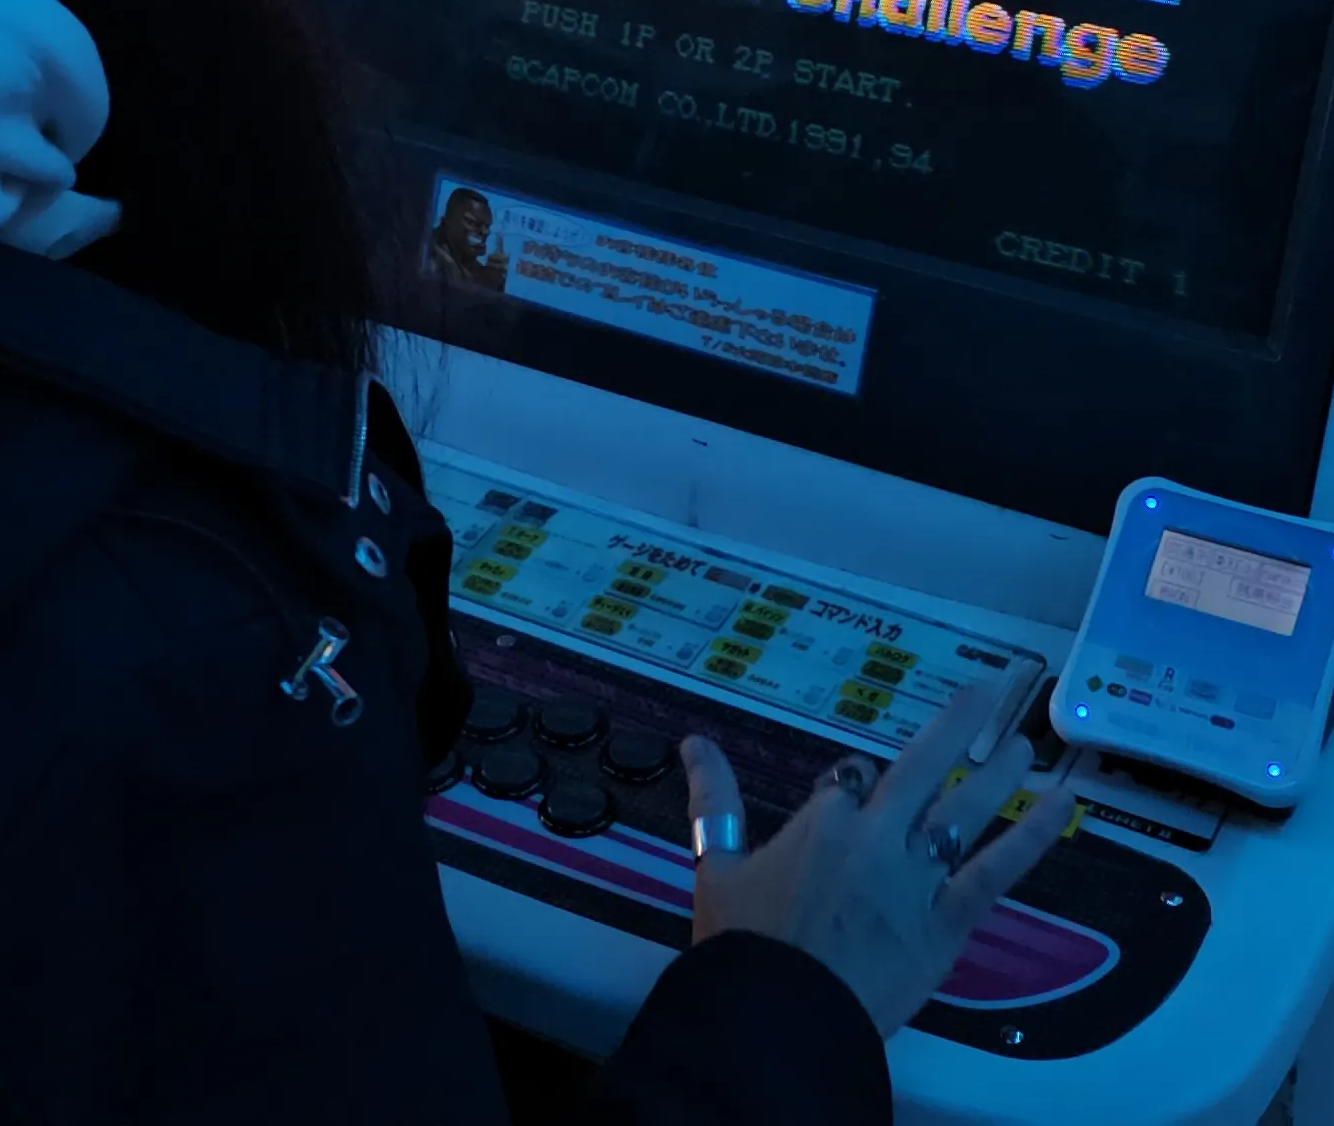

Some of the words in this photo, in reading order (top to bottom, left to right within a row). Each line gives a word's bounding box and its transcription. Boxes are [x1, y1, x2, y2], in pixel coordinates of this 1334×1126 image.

[520, 0, 600, 38] PUSH
[620, 21, 656, 49] 1P
[675, 33, 715, 64] OR
[733, 44, 774, 77] 2P
[995, 231, 1146, 285] CREDIT
[1174, 269, 1188, 297] 1
